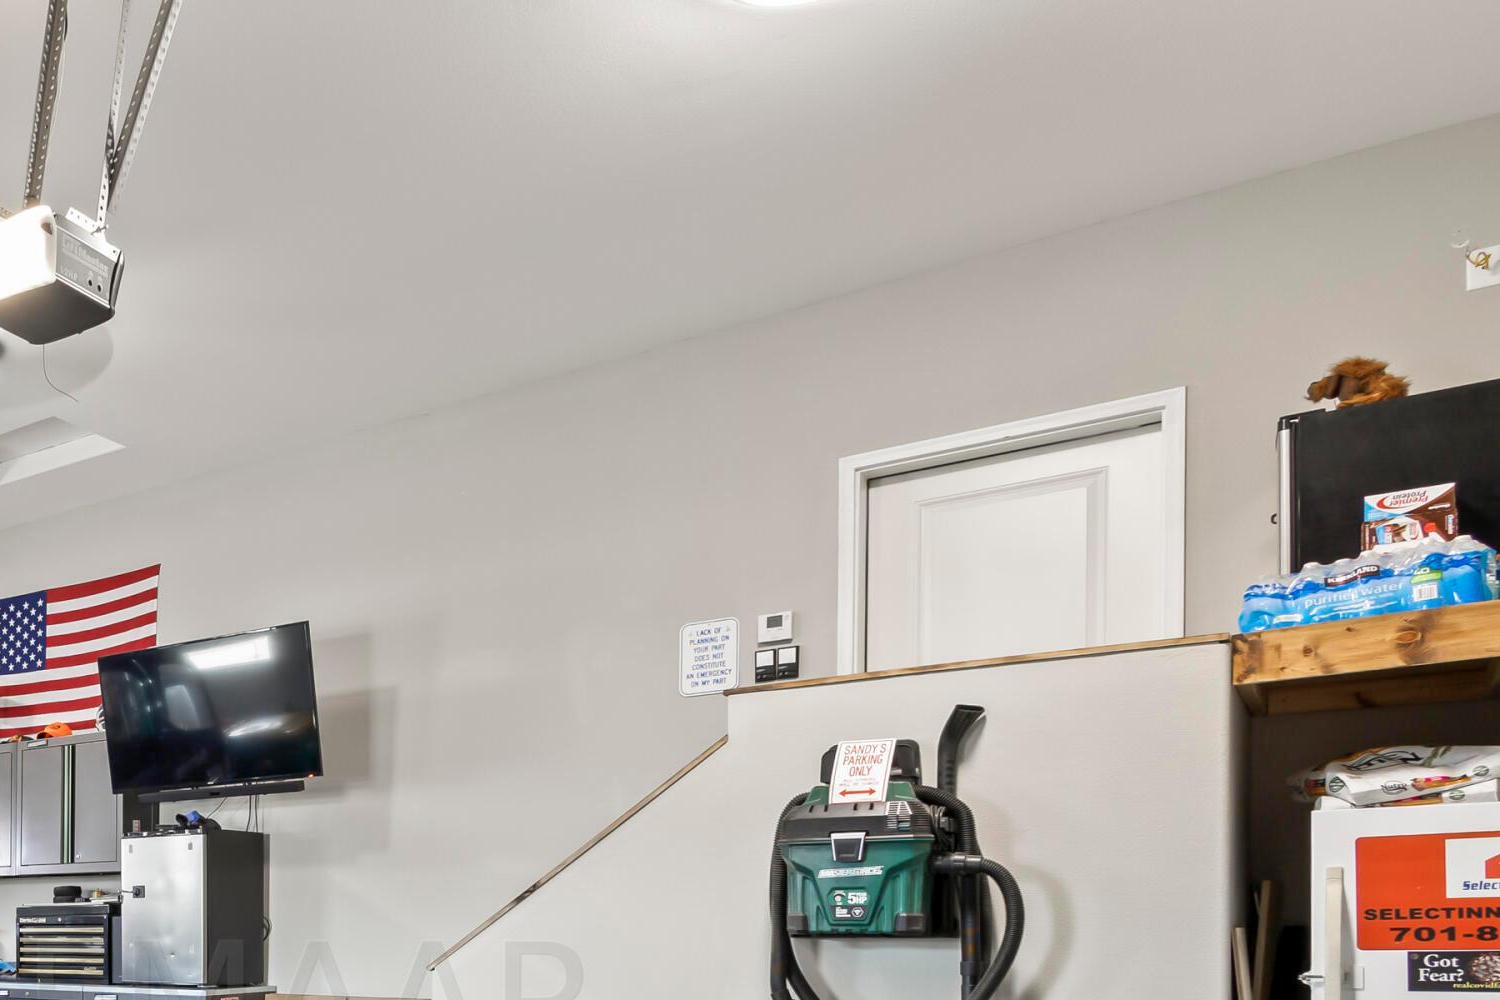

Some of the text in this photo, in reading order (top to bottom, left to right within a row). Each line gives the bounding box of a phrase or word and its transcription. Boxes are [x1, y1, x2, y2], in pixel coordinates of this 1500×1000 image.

[1360, 581, 1402, 596] water
[690, 636, 719, 645] PLANNING
[693, 646, 709, 654] YOUR
[694, 654, 709, 662] DOES
[692, 661, 726, 670] CONSTITUTE
[697, 669, 732, 678] EMERGENCY
[843, 754, 884, 766] PARKING
[849, 765, 873, 776] ONLY
[1462, 880, 1500, 891] Selec
[847, 892, 855, 905] 5
[1389, 925, 1500, 942] 701-8
[1423, 953, 1460, 968] Got
[1417, 968, 1464, 982] Fear?
